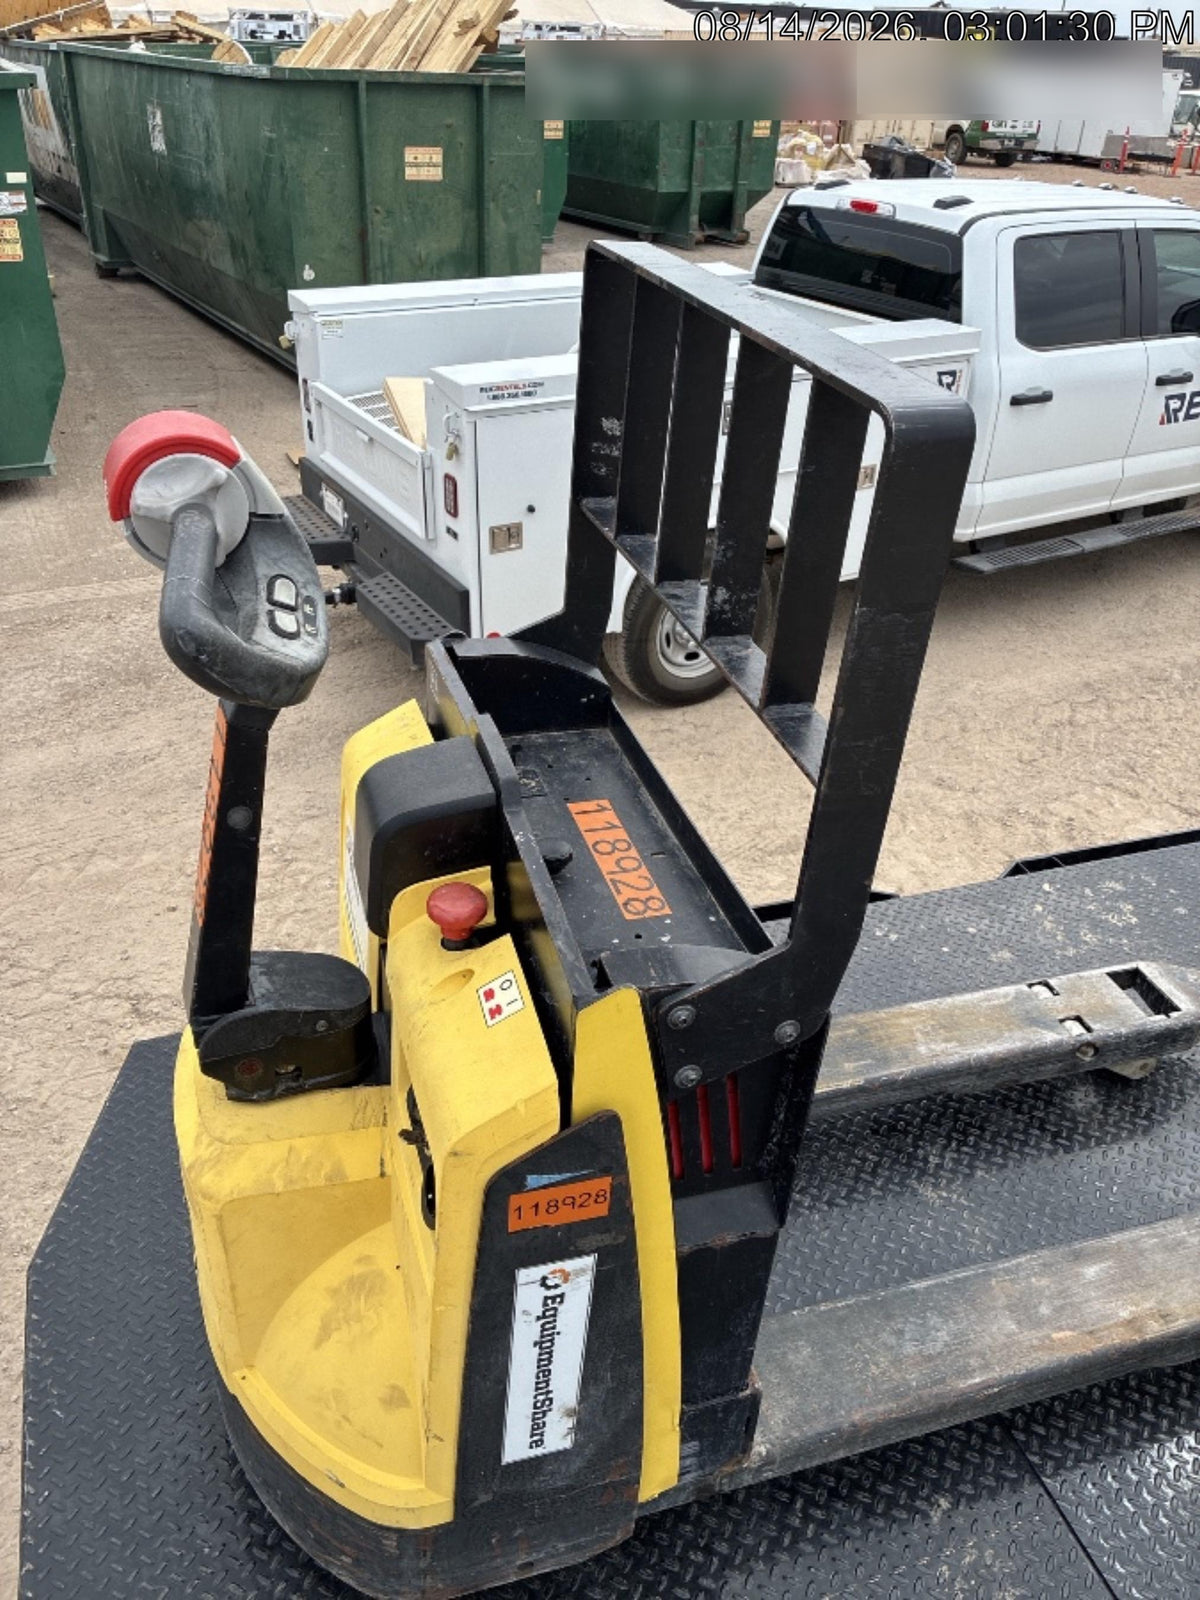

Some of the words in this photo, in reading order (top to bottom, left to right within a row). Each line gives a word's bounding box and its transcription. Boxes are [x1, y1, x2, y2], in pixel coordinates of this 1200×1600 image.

[573, 802, 666, 916] 118928
[513, 1188, 608, 1221] 118928
[528, 1291, 566, 1450] EquipmentShare
